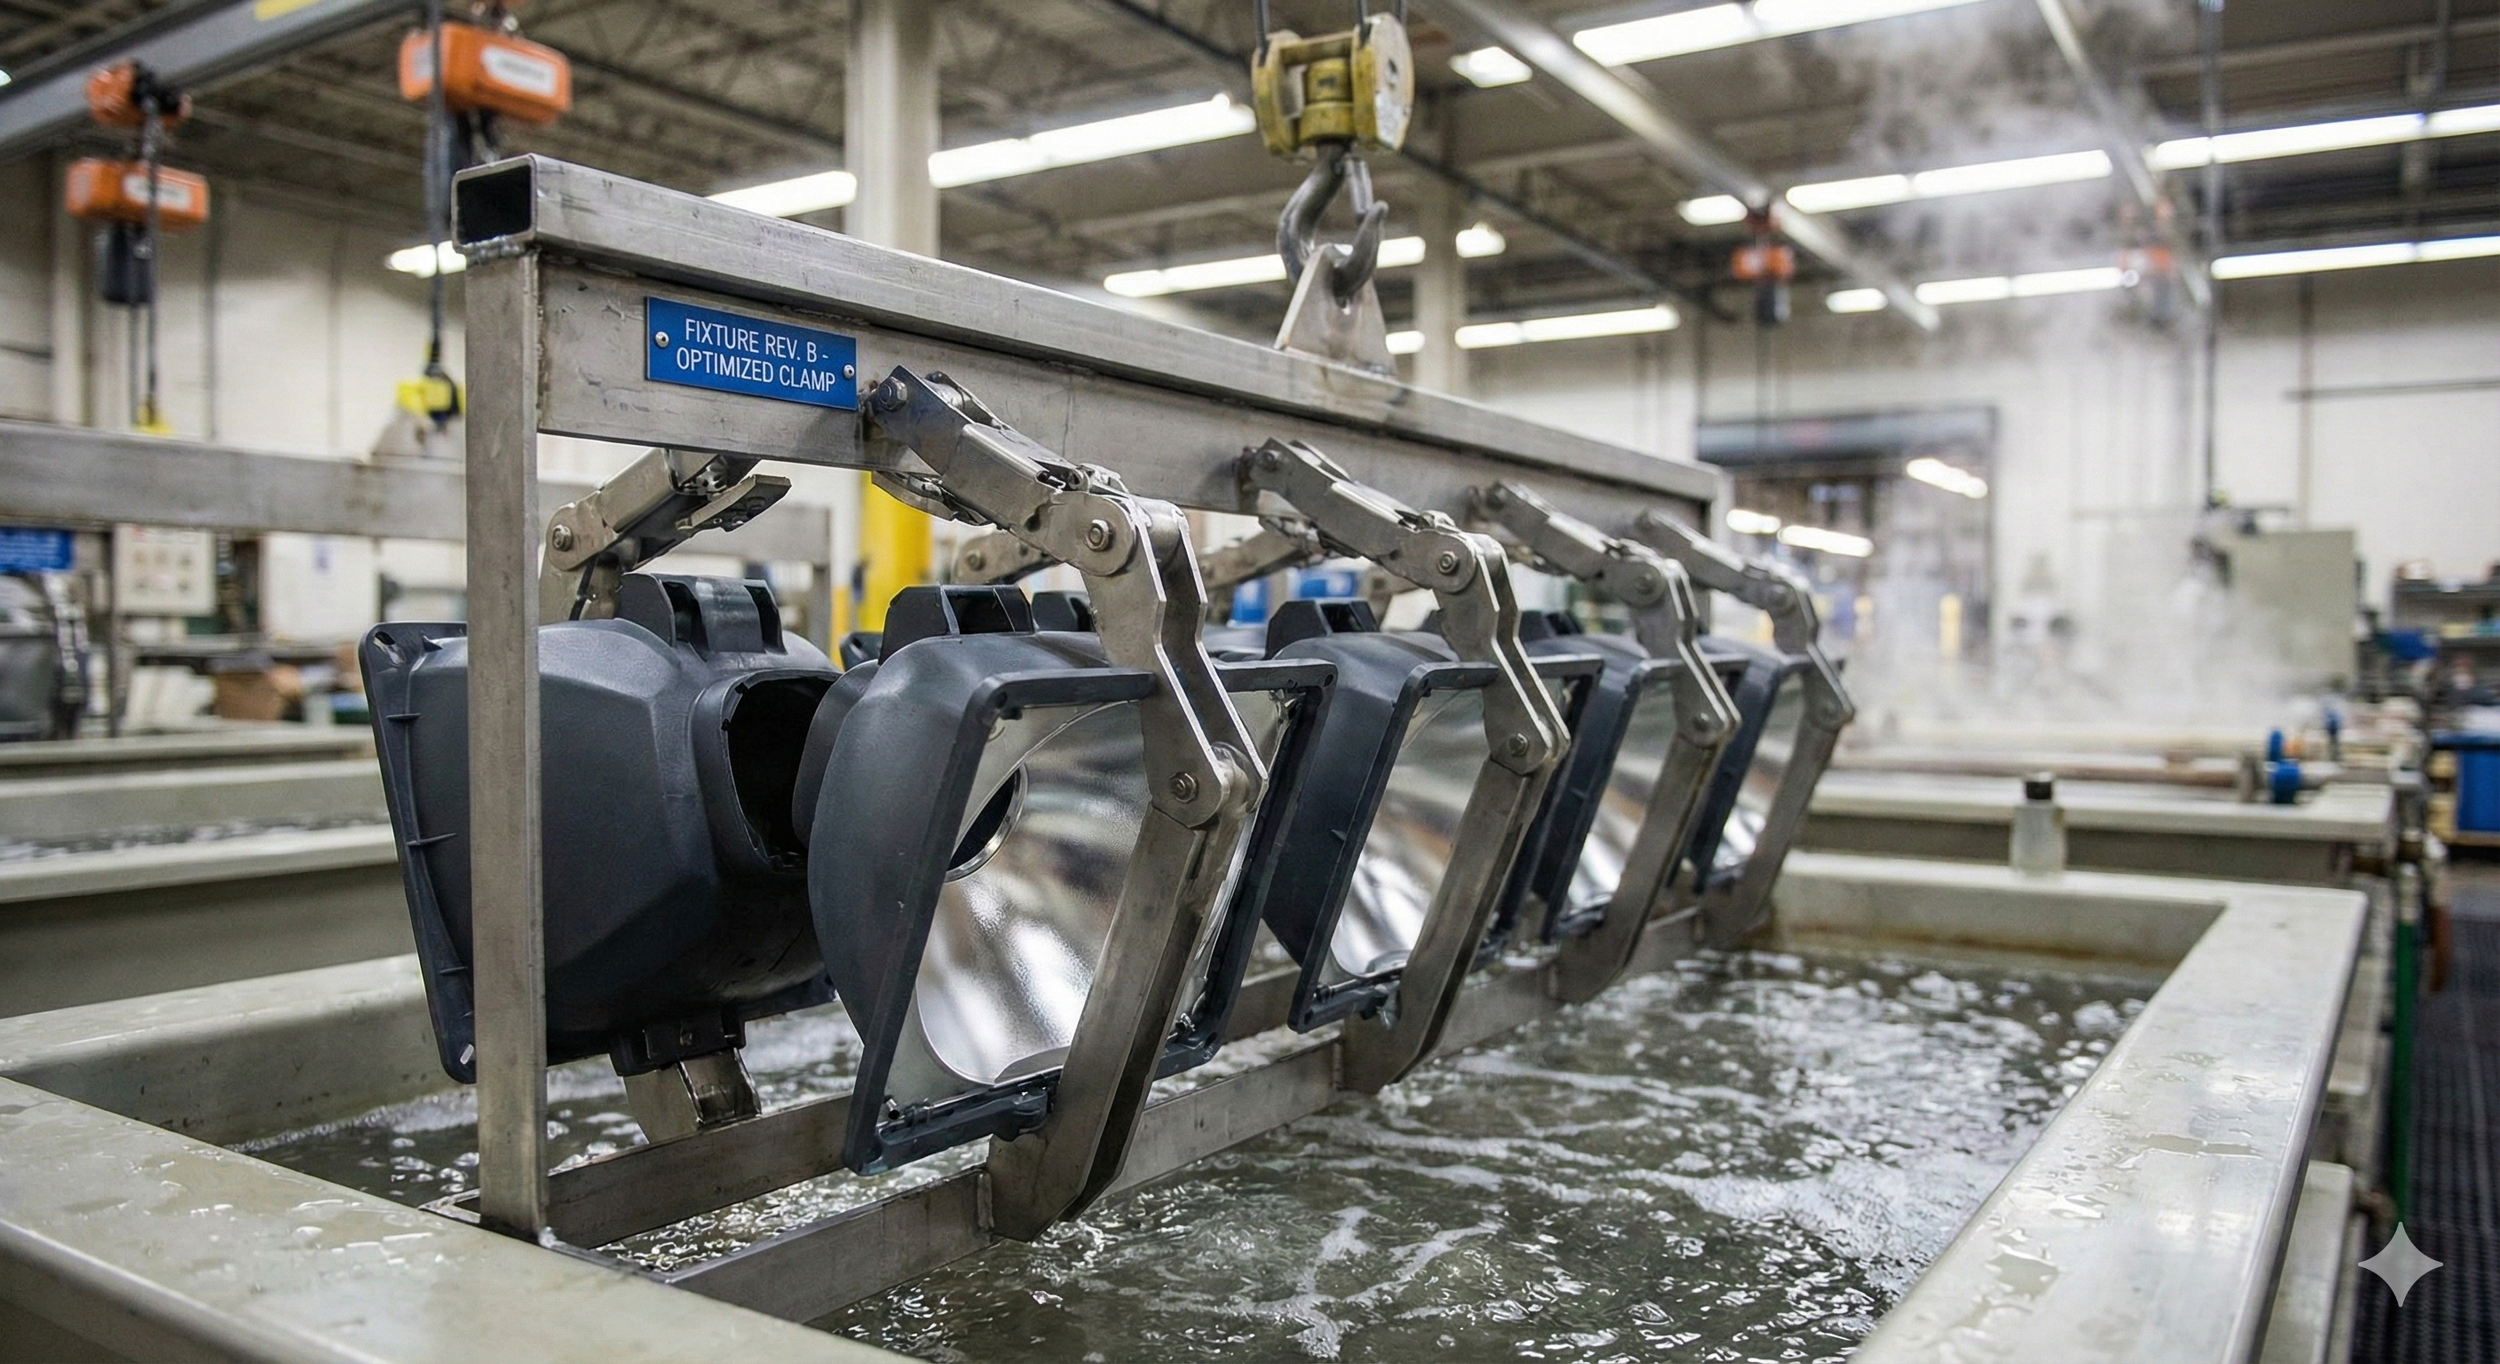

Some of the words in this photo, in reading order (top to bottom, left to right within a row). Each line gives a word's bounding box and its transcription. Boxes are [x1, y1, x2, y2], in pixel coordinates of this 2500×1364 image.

[685, 318, 760, 354] FIXTURE
[765, 333, 801, 361] REV.
[806, 341, 818, 363] B
[676, 346, 774, 383] OPTIMIZED
[779, 364, 836, 392] CLAMP
